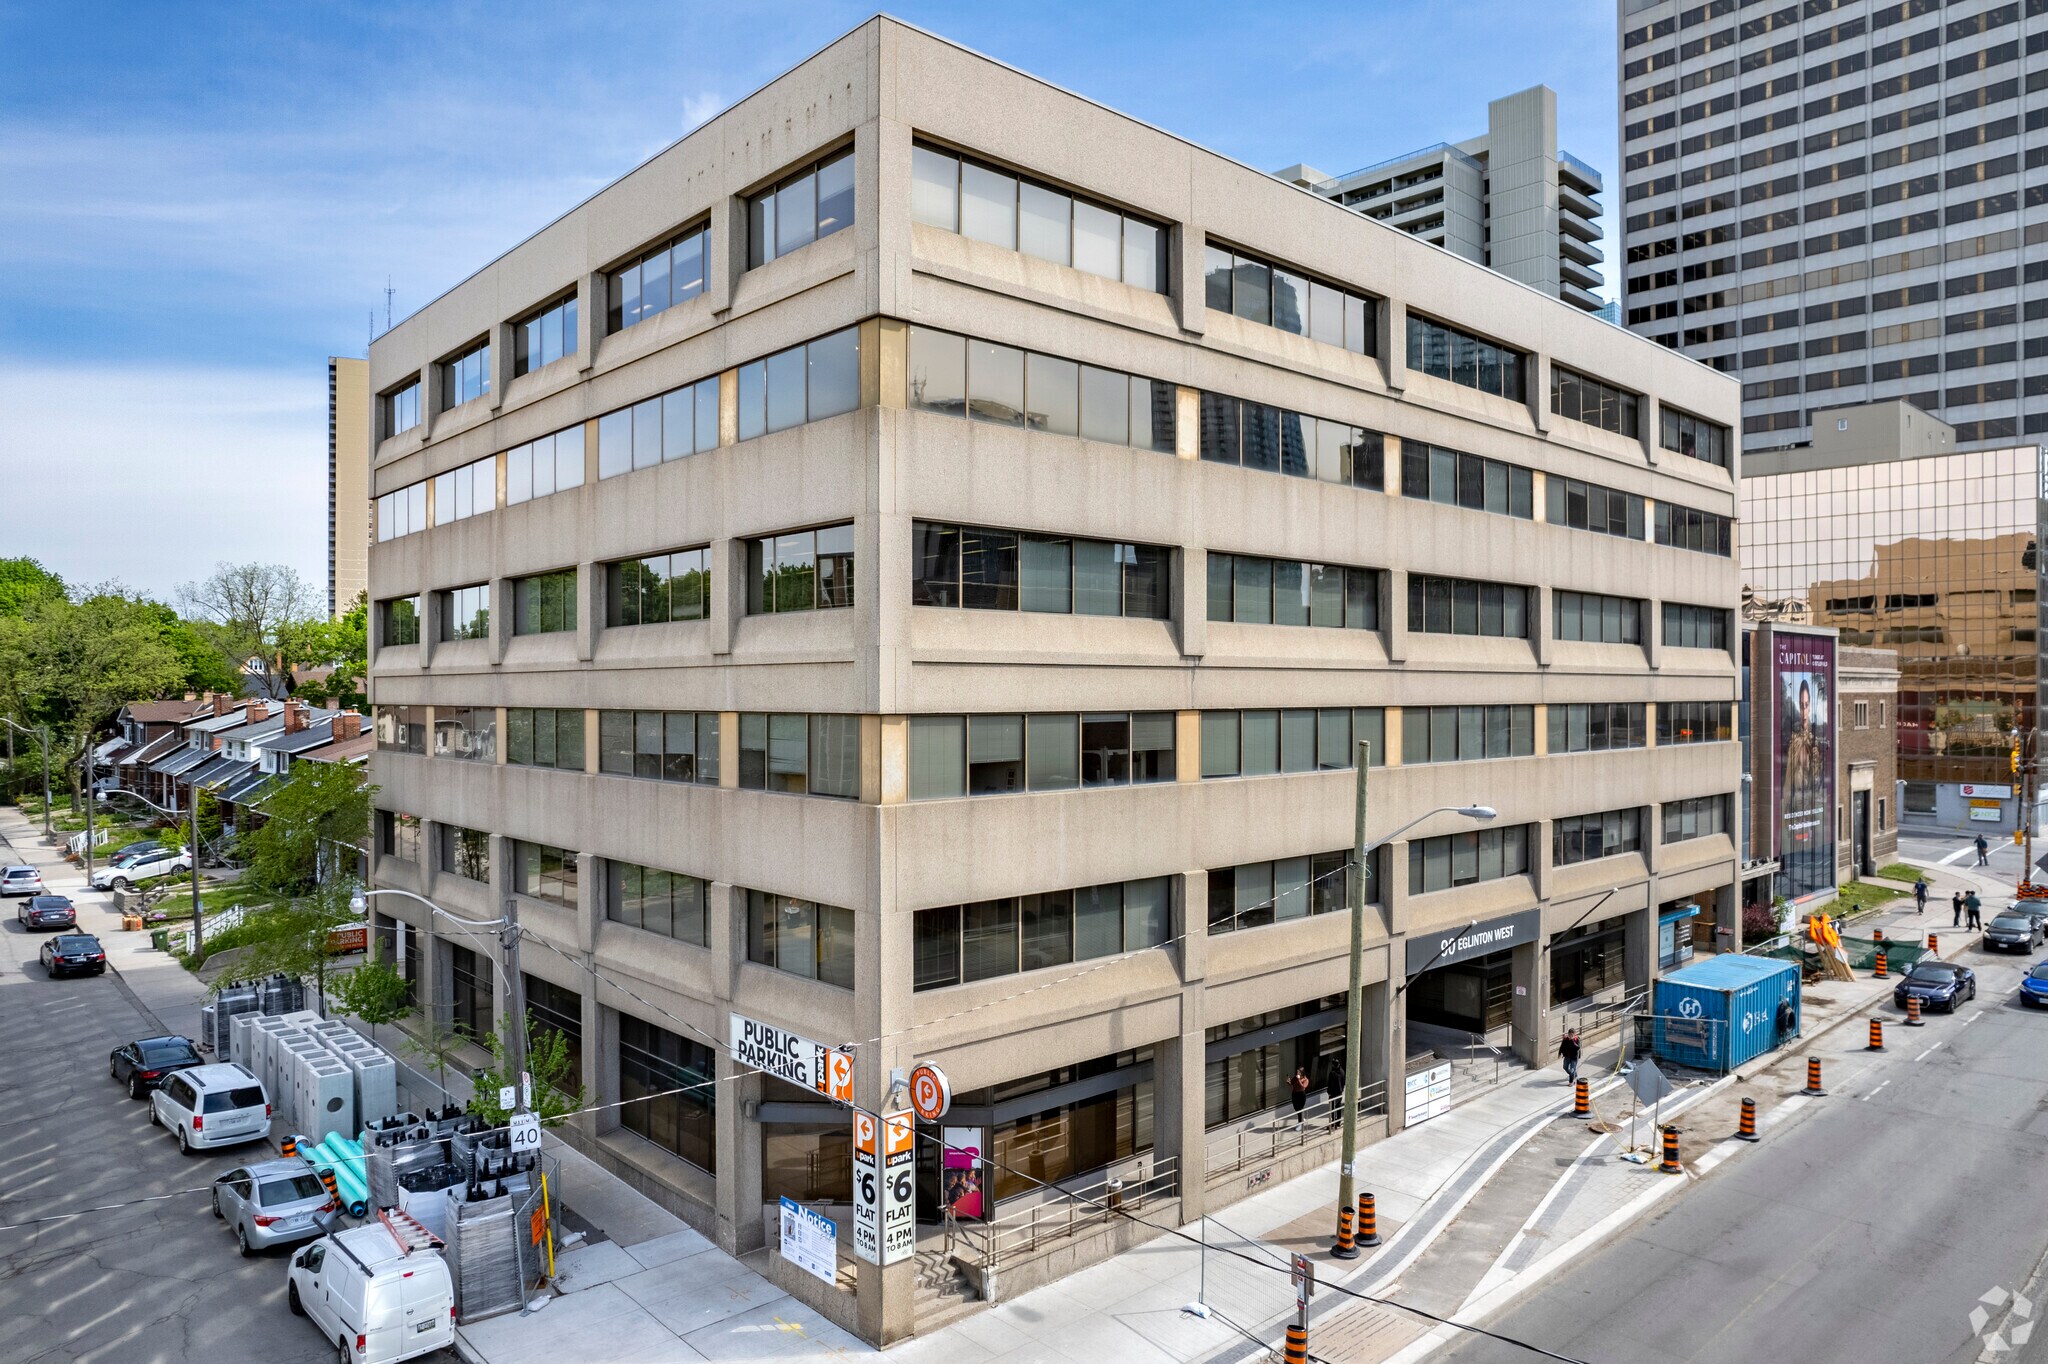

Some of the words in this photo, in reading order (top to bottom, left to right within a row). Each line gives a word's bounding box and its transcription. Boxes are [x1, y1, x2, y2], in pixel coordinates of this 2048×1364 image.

[1779, 652, 1809, 665] CAPITOL
[1441, 938, 1455, 957] 90
[1458, 929, 1493, 950] EGLINTON
[1494, 925, 1514, 941] WEST
[744, 1020, 799, 1059] PUBLIC
[739, 1039, 807, 1084] PARKING
[816, 1046, 826, 1092] upark
[916, 1069, 937, 1082] PUBLIC
[514, 1128, 538, 1145] 40
[856, 1151, 875, 1165] upark
[887, 1151, 911, 1165] upark
[856, 1168, 876, 1205] $6
[886, 1170, 912, 1203] $6
[799, 1205, 832, 1235] Notice
[856, 1203, 875, 1222] FLAT
[886, 1204, 912, 1222] FLAT
[856, 1227, 862, 1237] 4
[863, 1230, 875, 1245] PM
[886, 1233, 893, 1244] 4
[896, 1227, 912, 1241] PM
[856, 1238, 863, 1247] TO
[868, 1243, 876, 1253] AM
[886, 1244, 896, 1252] TO
[902, 1239, 912, 1247] AM
